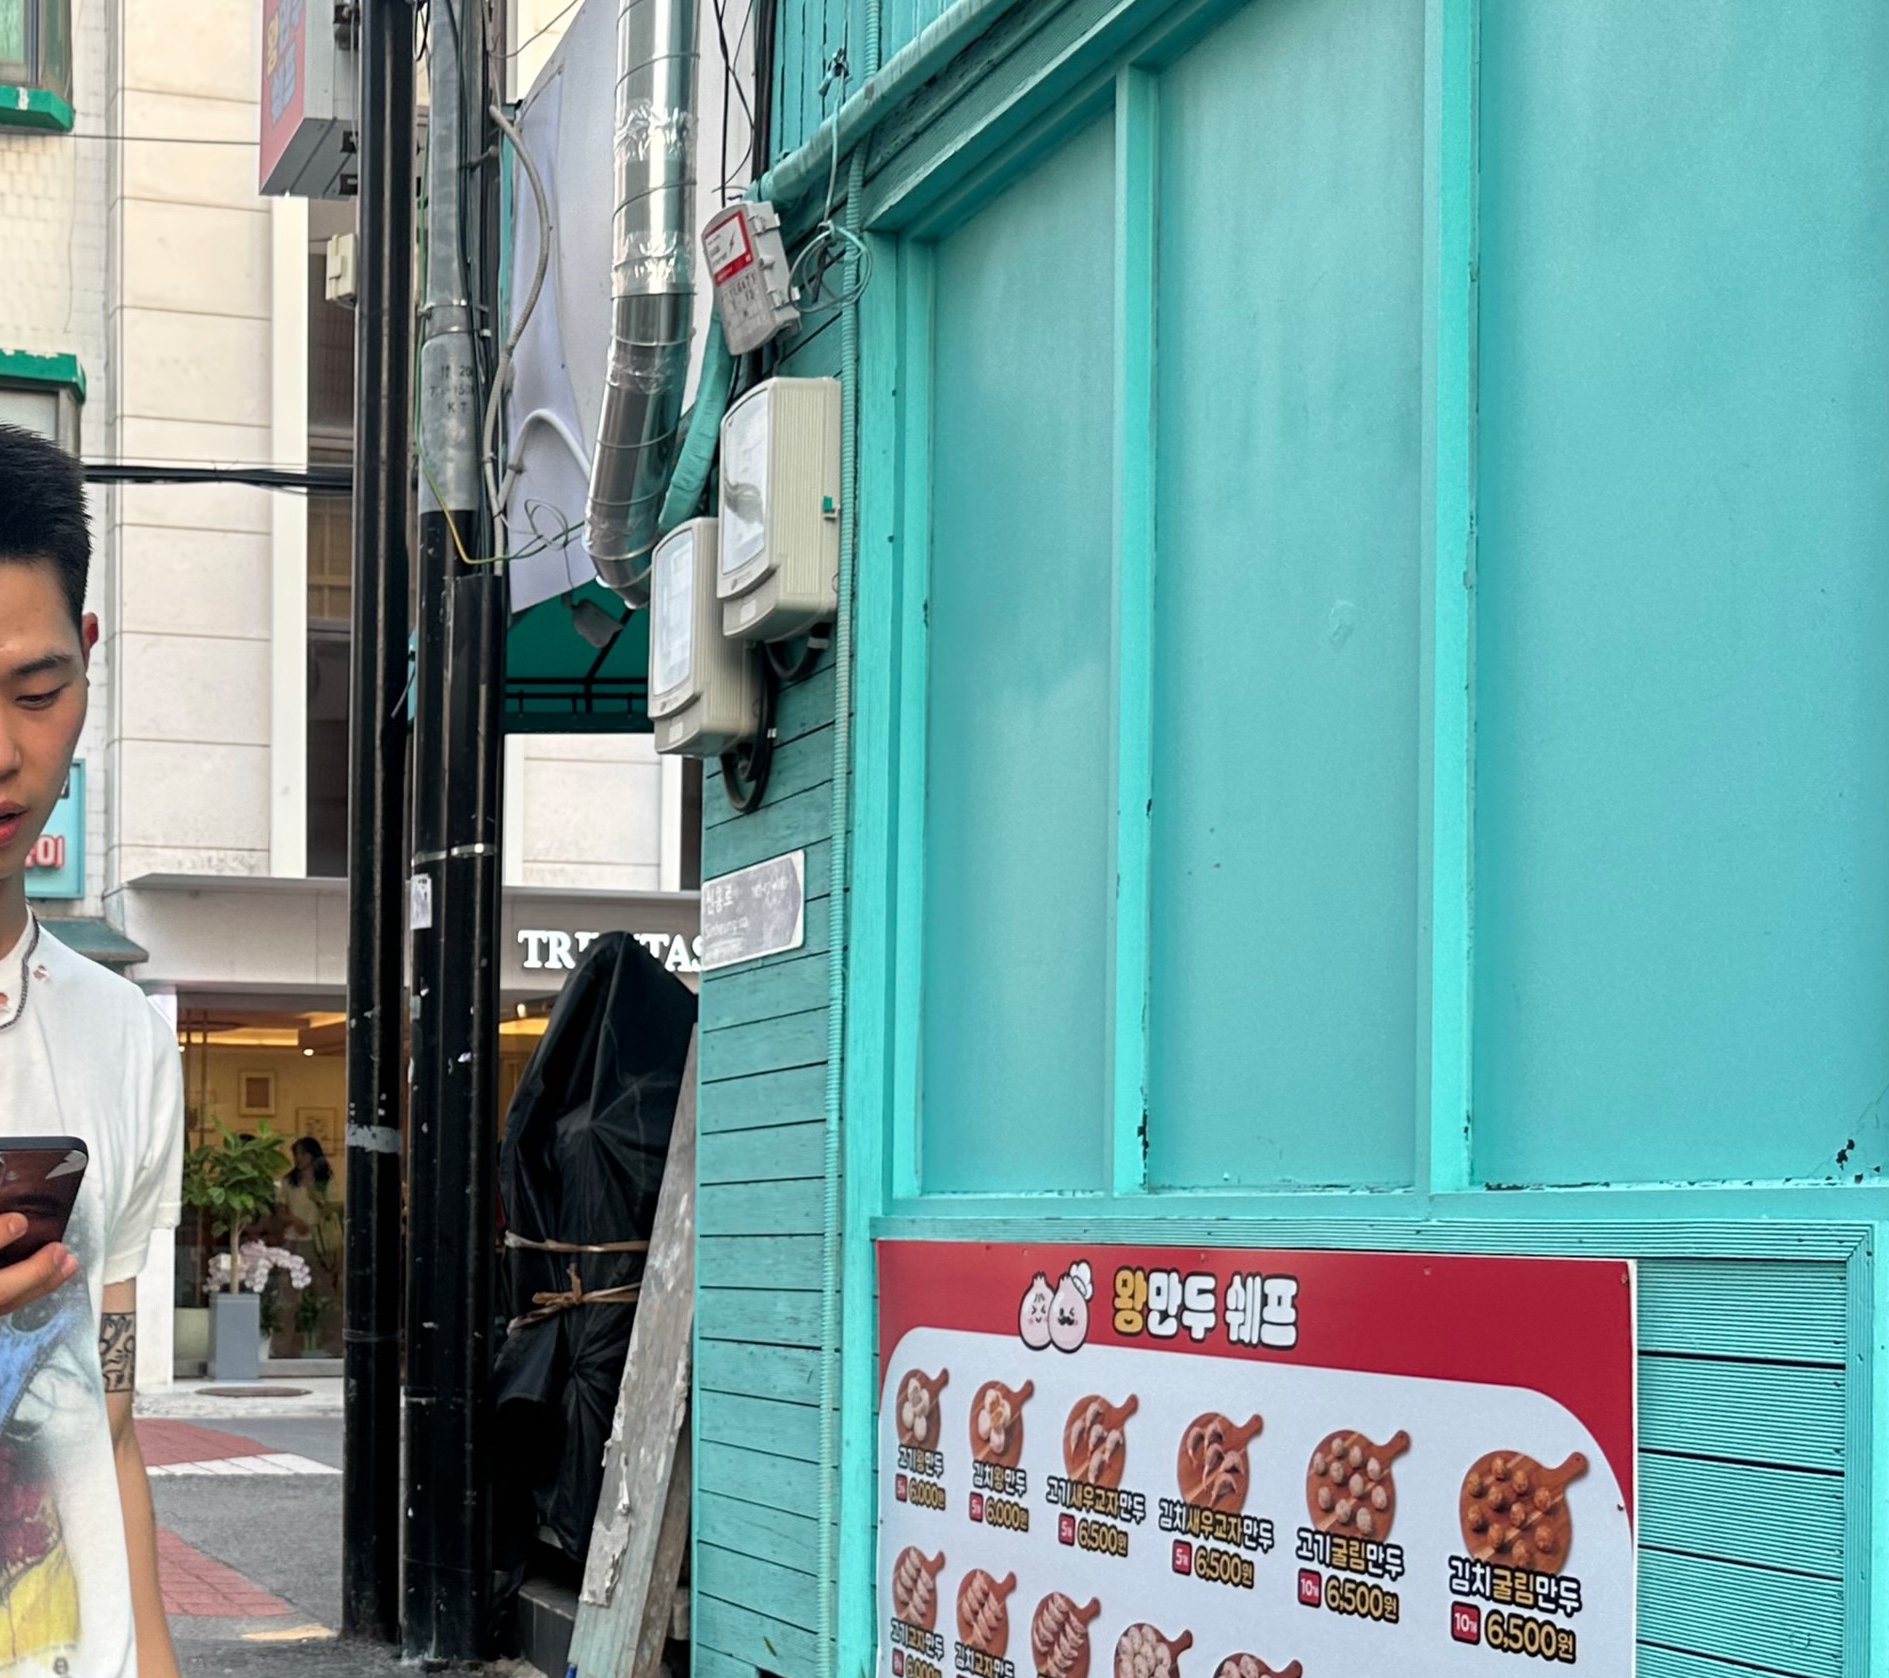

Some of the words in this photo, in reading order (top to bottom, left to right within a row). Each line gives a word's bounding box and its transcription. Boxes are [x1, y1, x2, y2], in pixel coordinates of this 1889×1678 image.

[25, 834, 65, 868] 이
[1113, 1267, 1217, 1341] 왕만두
[1224, 1273, 1300, 1347] 쉐프
[973, 1460, 1027, 1497] 김치왕만두
[1046, 1477, 1146, 1523] 고기새우교자만두
[986, 1498, 1029, 1531] 6,000원
[1078, 1519, 1128, 1555] 6,500원
[1159, 1499, 1274, 1553] 김치새우교자만두
[1195, 1547, 1254, 1586] 6,500원
[1296, 1529, 1404, 1580] 고기굴림만두
[1326, 1577, 1398, 1621] 6,500원
[1449, 1558, 1581, 1615] 김치굴림만두
[1486, 1611, 1575, 1661] 6,500원
